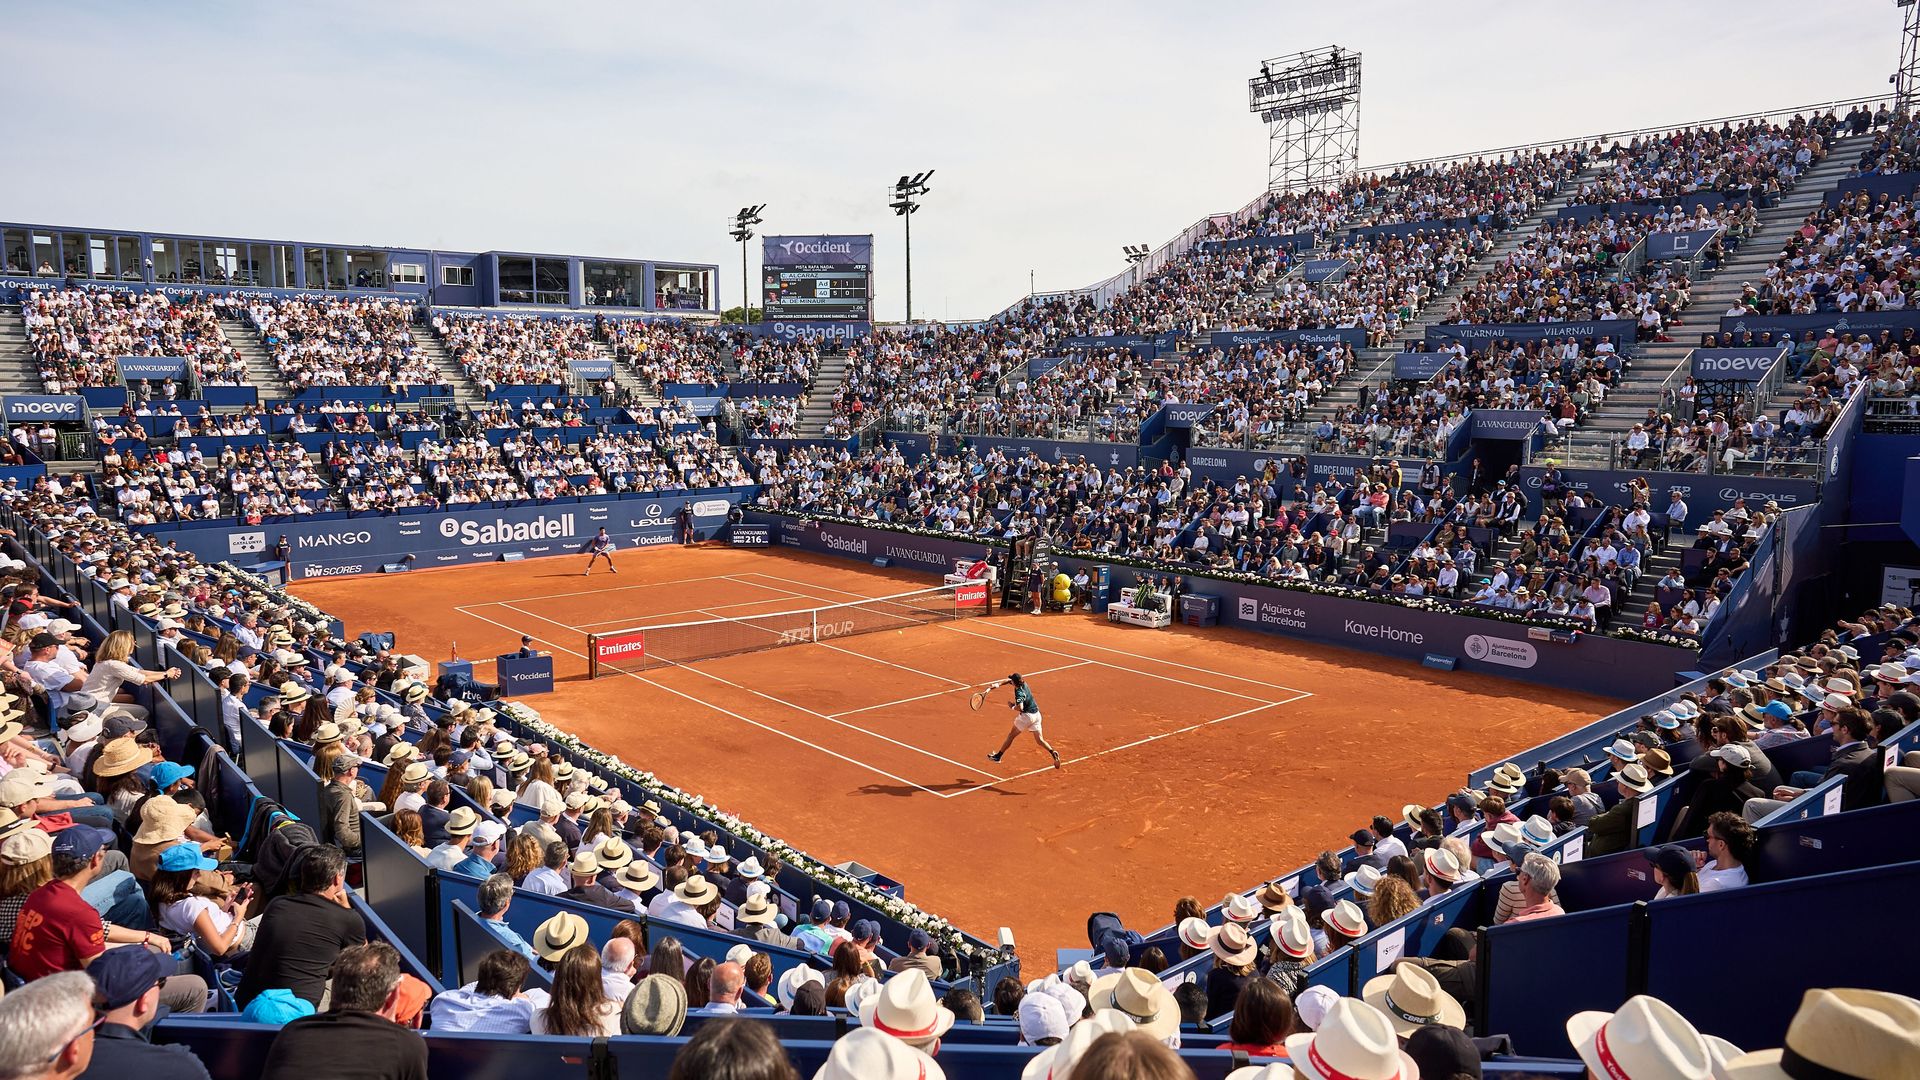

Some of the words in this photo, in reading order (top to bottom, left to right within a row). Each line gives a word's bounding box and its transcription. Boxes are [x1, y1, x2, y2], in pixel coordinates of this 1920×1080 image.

[795, 241, 851, 254] Occident
[9, 281, 49, 289] Occident
[306, 293, 337, 301] Occient
[785, 324, 854, 339] Sabadell
[1460, 329, 1505, 338] VILARNAU
[1544, 327, 1594, 336] VILARNAU
[1238, 336, 1270, 344] Sabadll
[1305, 334, 1340, 342] Sabadell
[1700, 357, 1772, 370] moeve
[12, 402, 77, 414] moeve
[1476, 420, 1487, 428] LA
[1486, 420, 1538, 429] VANGUARDIA
[1192, 456, 1227, 467] BARCELONA
[1313, 464, 1355, 476] BARCELONA
[1667, 485, 1692, 493] ATP
[1740, 492, 1797, 502] LEXUS
[631, 516, 677, 528] LEXUS
[460, 513, 575, 546] Sabadell
[299, 531, 371, 548] MANGO
[640, 534, 673, 544] Occident
[745, 535, 762, 543] 216
[827, 535, 867, 554] Sabadell
[886, 546, 896, 557] LA
[893, 547, 946, 565] VANGUARDIA
[322, 564, 362, 576] SCORES
[957, 591, 986, 602] Emirates
[1261, 602, 1292, 616] Aigües
[1293, 608, 1306, 618] de
[1261, 613, 1306, 629] Barcelona
[779, 626, 812, 642] ATP
[816, 620, 854, 638] TOUR
[1345, 619, 1378, 637] Kave
[1380, 624, 1424, 644] Home
[599, 640, 642, 656] Emirates
[1491, 642, 1520, 653] Ajuntament
[1491, 649, 1527, 661] Barcelona
[520, 671, 550, 680] Occident
[461, 690, 482, 701] rtve
[1403, 1013, 1426, 1024] CBRE
